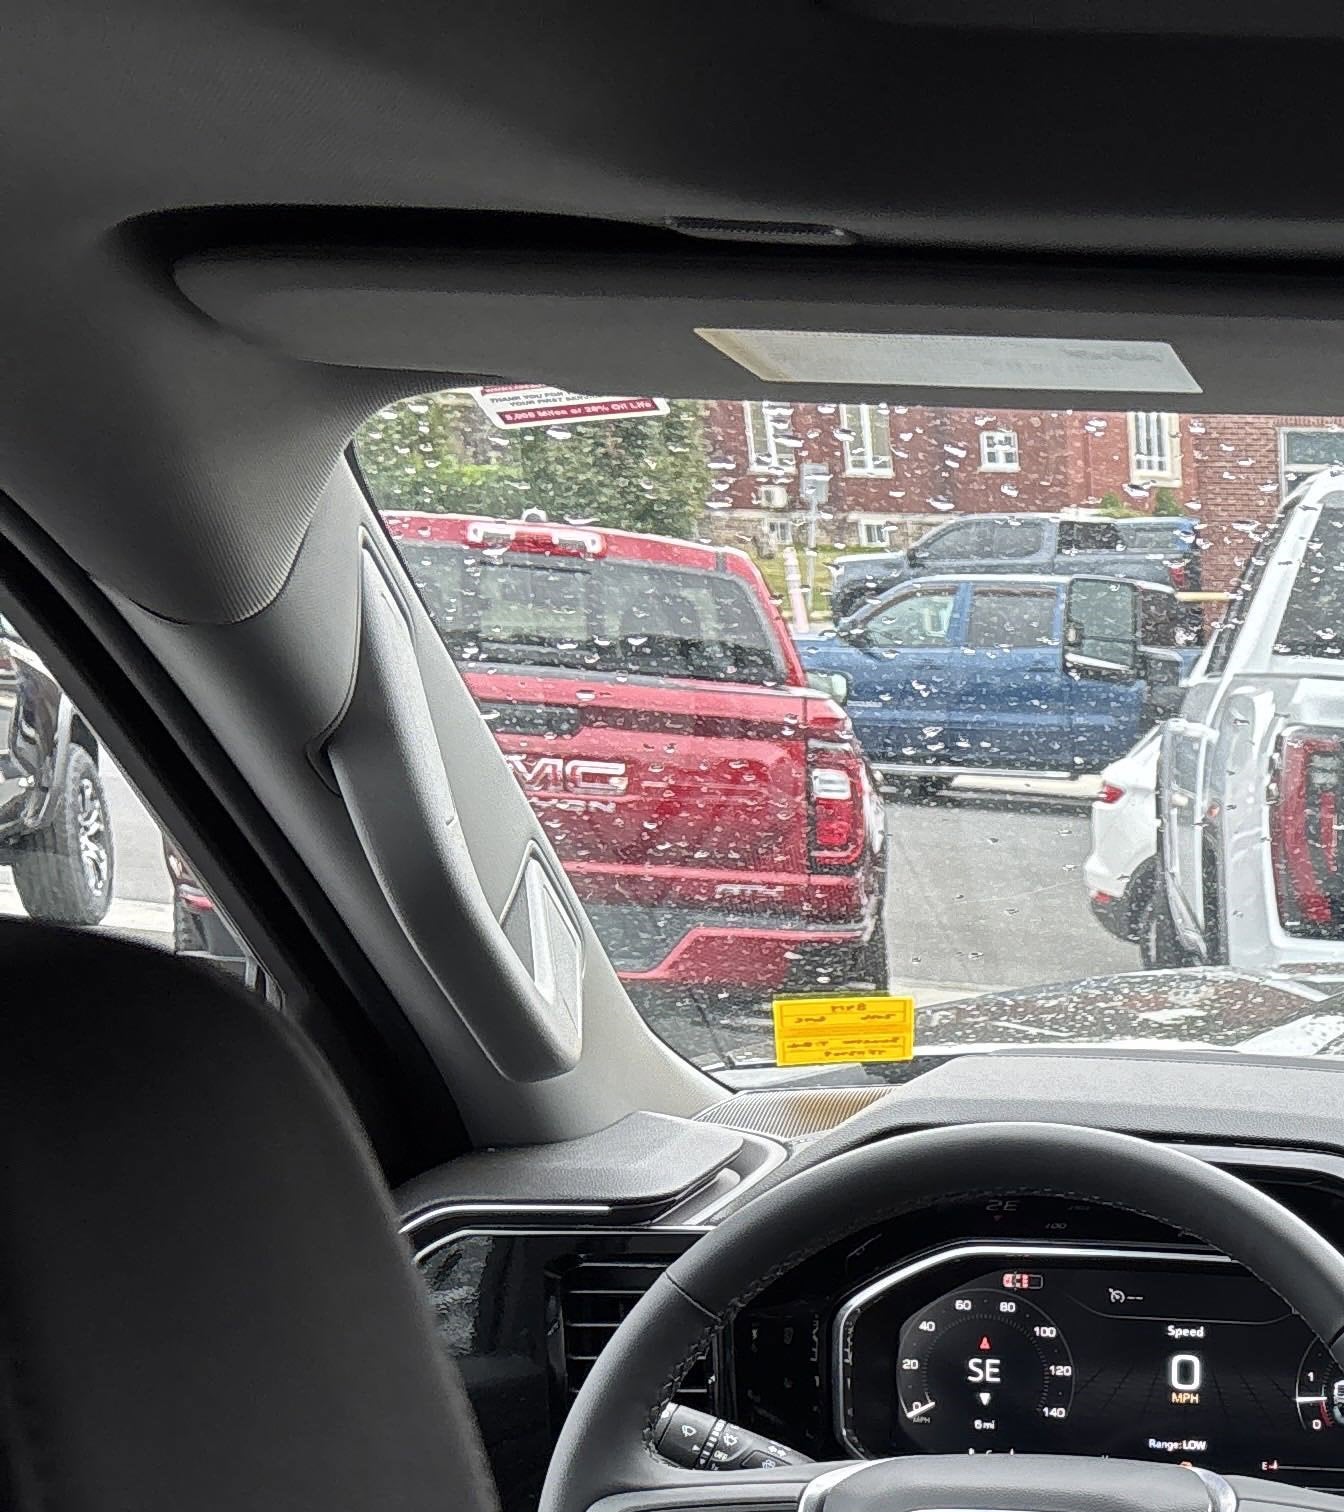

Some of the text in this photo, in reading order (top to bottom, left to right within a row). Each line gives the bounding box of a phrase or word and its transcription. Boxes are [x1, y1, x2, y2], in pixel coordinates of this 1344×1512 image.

[955, 1300, 972, 1311] 60
[1000, 1302, 1016, 1312] 80
[919, 1321, 936, 1332] 40
[1034, 1326, 1056, 1338] 100
[1168, 1325, 1205, 1338] Speed
[902, 1359, 919, 1370] 20
[968, 1358, 1000, 1382] SE
[1049, 1365, 1072, 1377] 120
[1171, 1354, 1200, 1390] 0
[1308, 1372, 1314, 1382] 1
[1172, 1392, 1199, 1404] MPH
[1043, 1407, 1066, 1418] 140
[1148, 1439, 1207, 1451] Range: LOW
